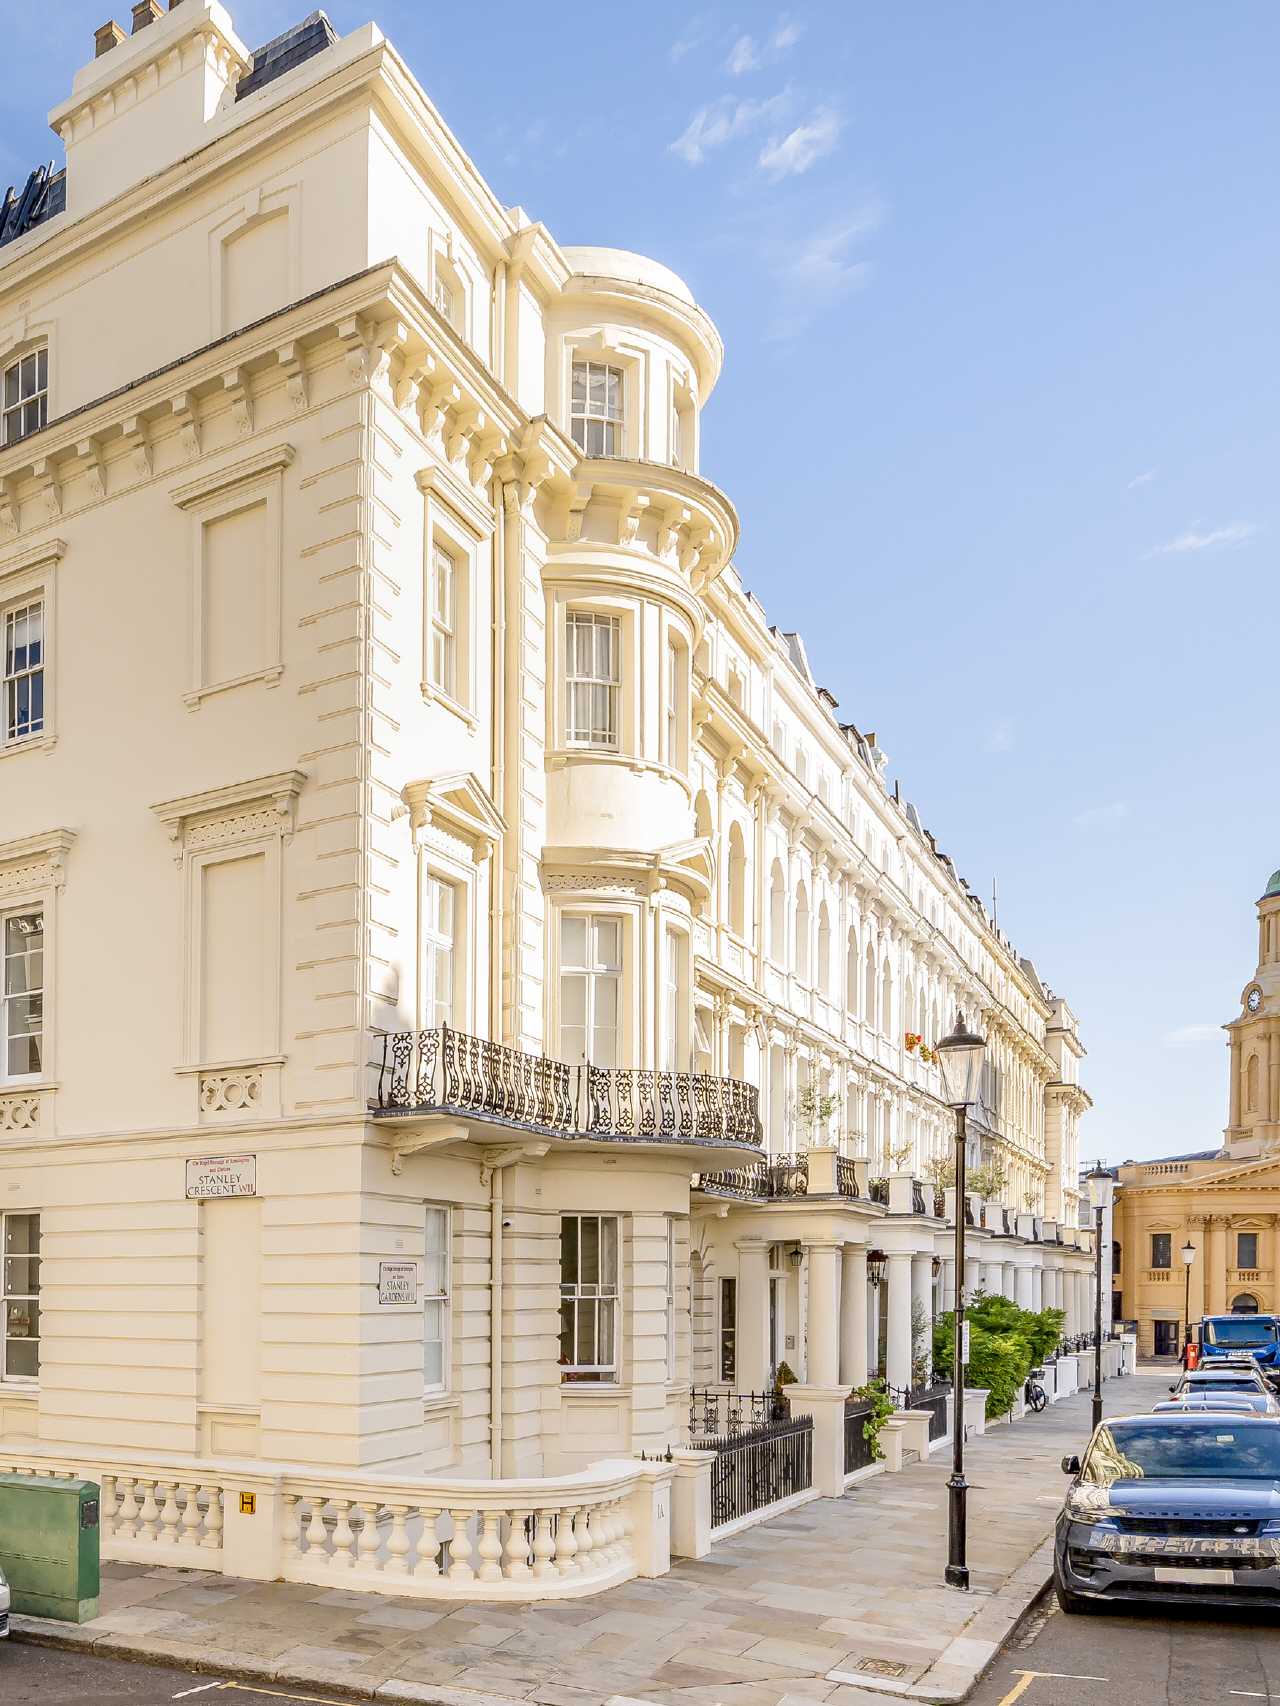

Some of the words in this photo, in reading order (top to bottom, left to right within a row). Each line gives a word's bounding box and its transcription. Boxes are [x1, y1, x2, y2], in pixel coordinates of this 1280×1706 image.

[199, 1174, 241, 1184] STANLEY
[187, 1185, 236, 1195] CRESCENT
[239, 1184, 253, 1193] W11
[387, 1280, 409, 1290] STANLEY
[380, 1292, 404, 1302] GARDENS
[241, 1493, 254, 1512] H
